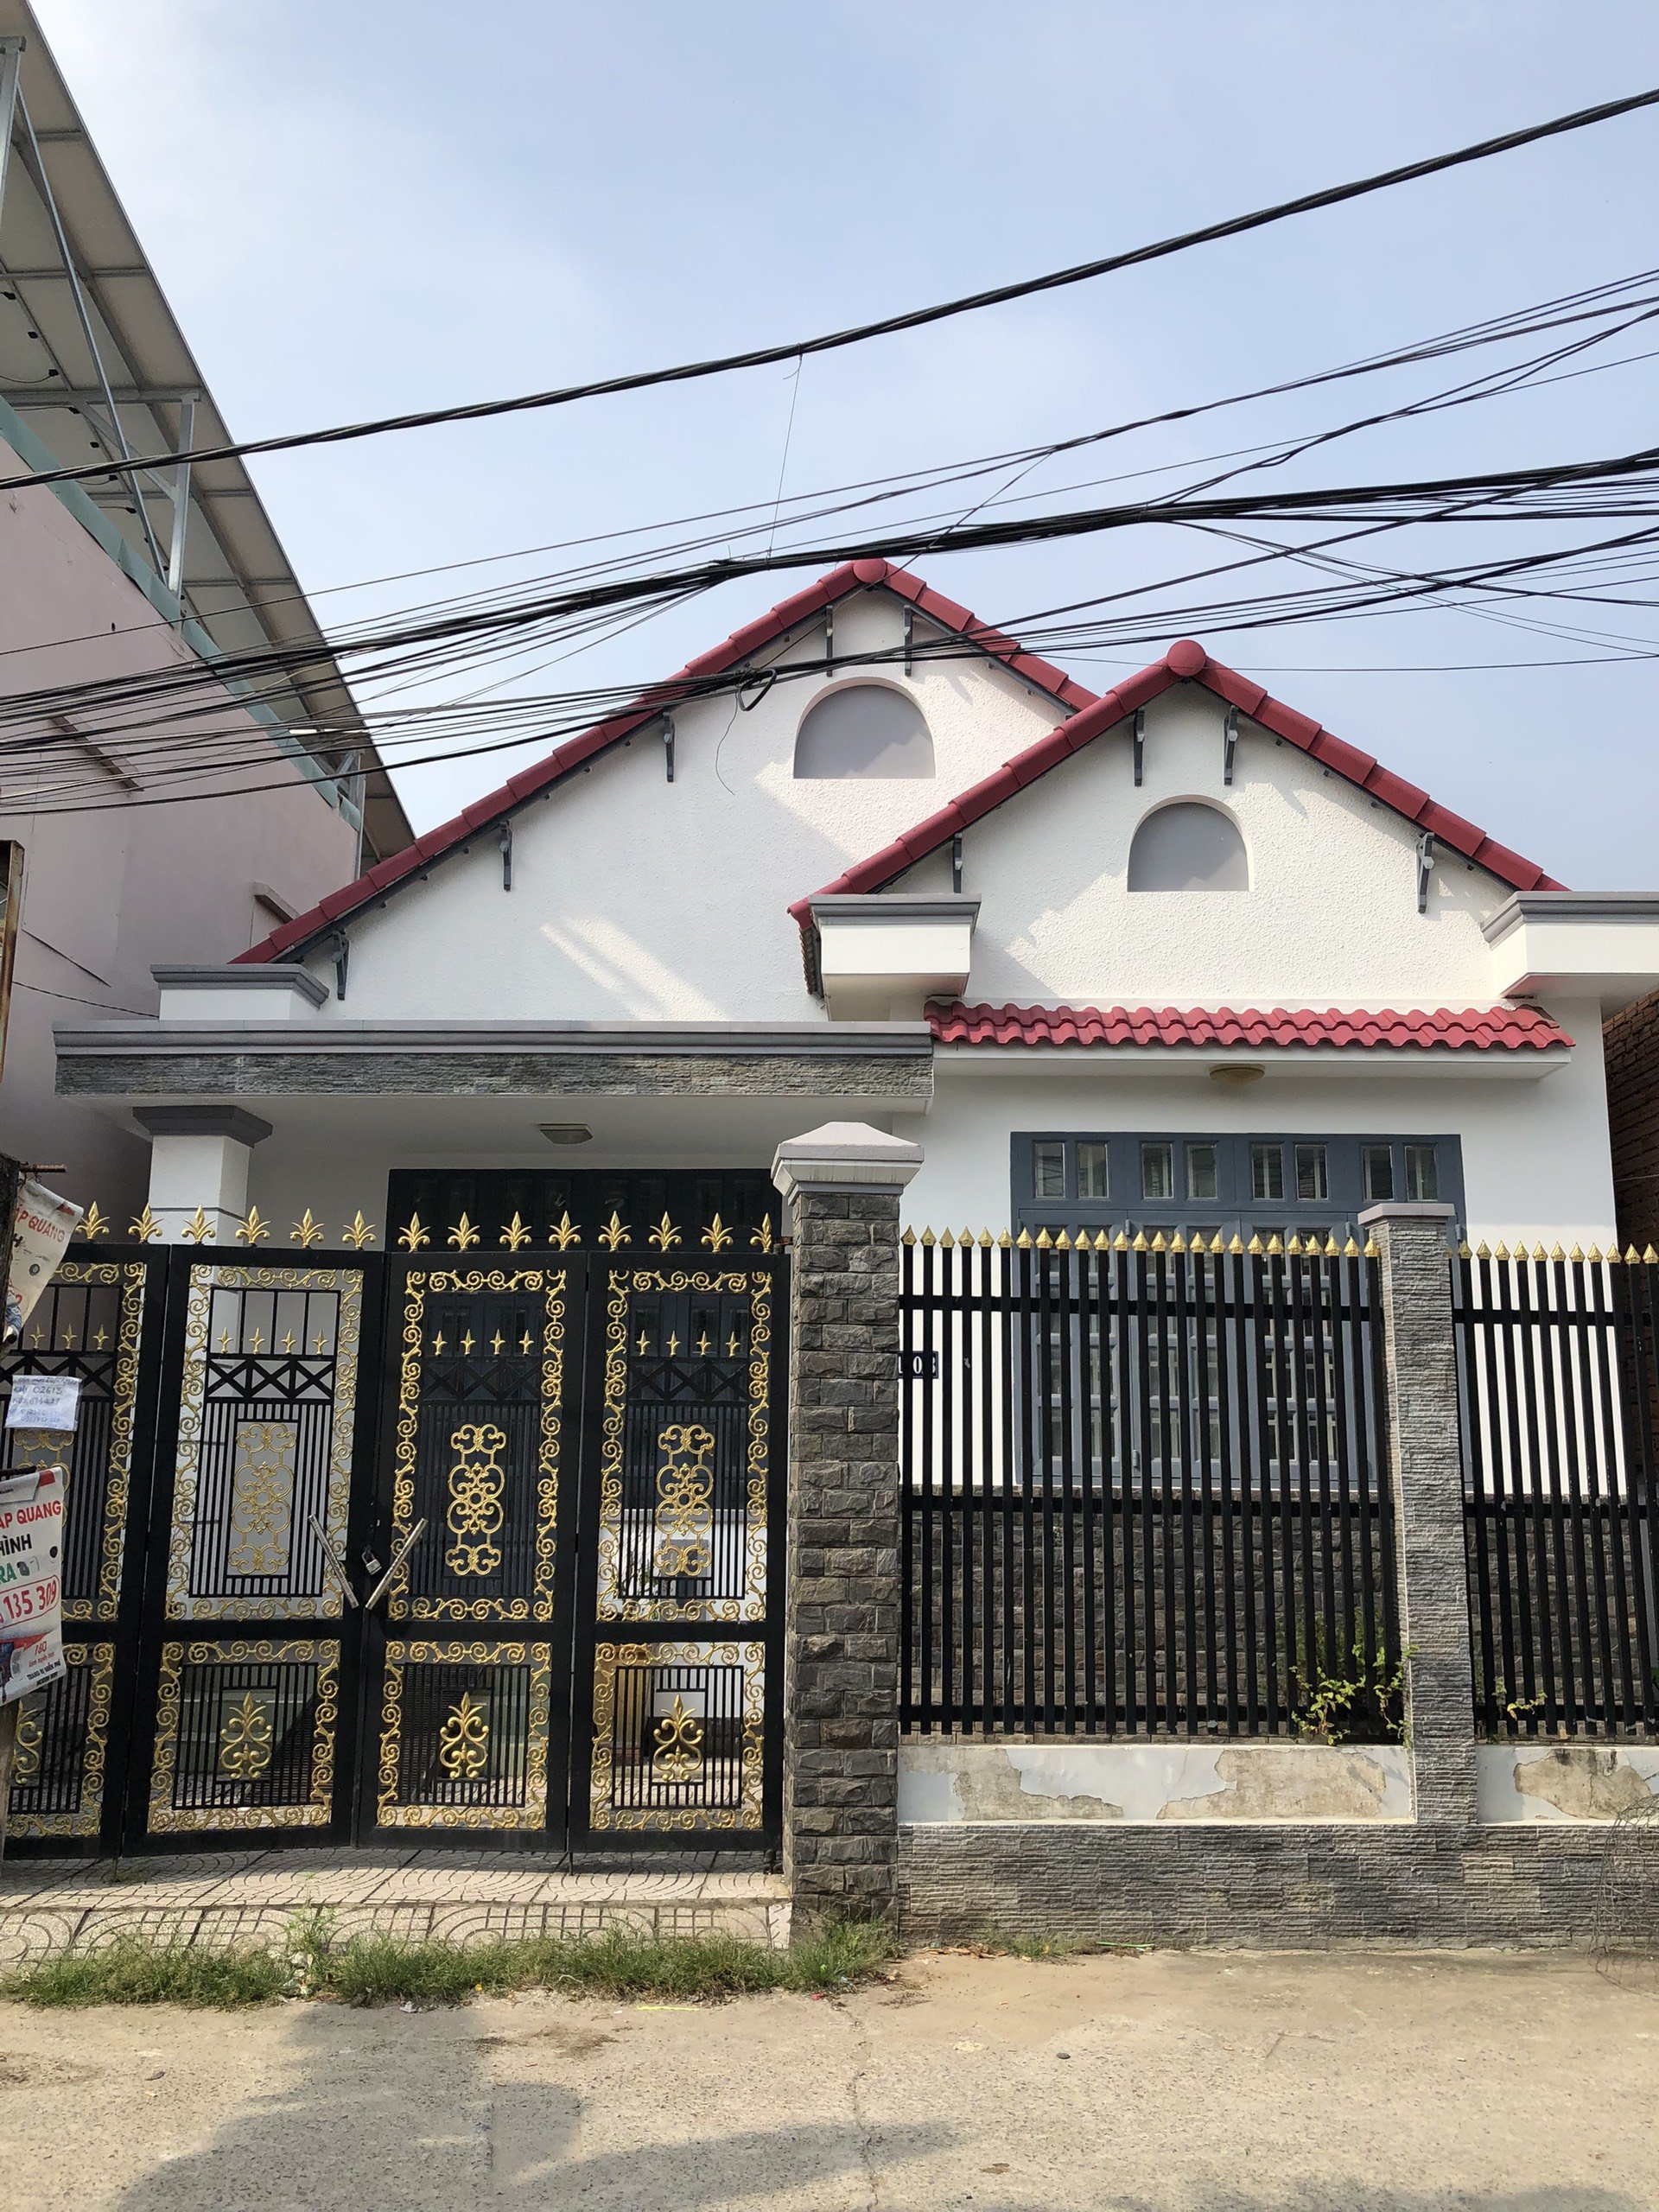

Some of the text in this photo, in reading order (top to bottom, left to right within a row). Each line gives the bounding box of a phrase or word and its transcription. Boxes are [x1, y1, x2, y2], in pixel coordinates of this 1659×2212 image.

[28, 1215, 65, 1243] QUANG
[16, 1500, 61, 1525] QUANG
[3, 1590, 33, 1619] 135
[35, 1580, 56, 1610] 309
